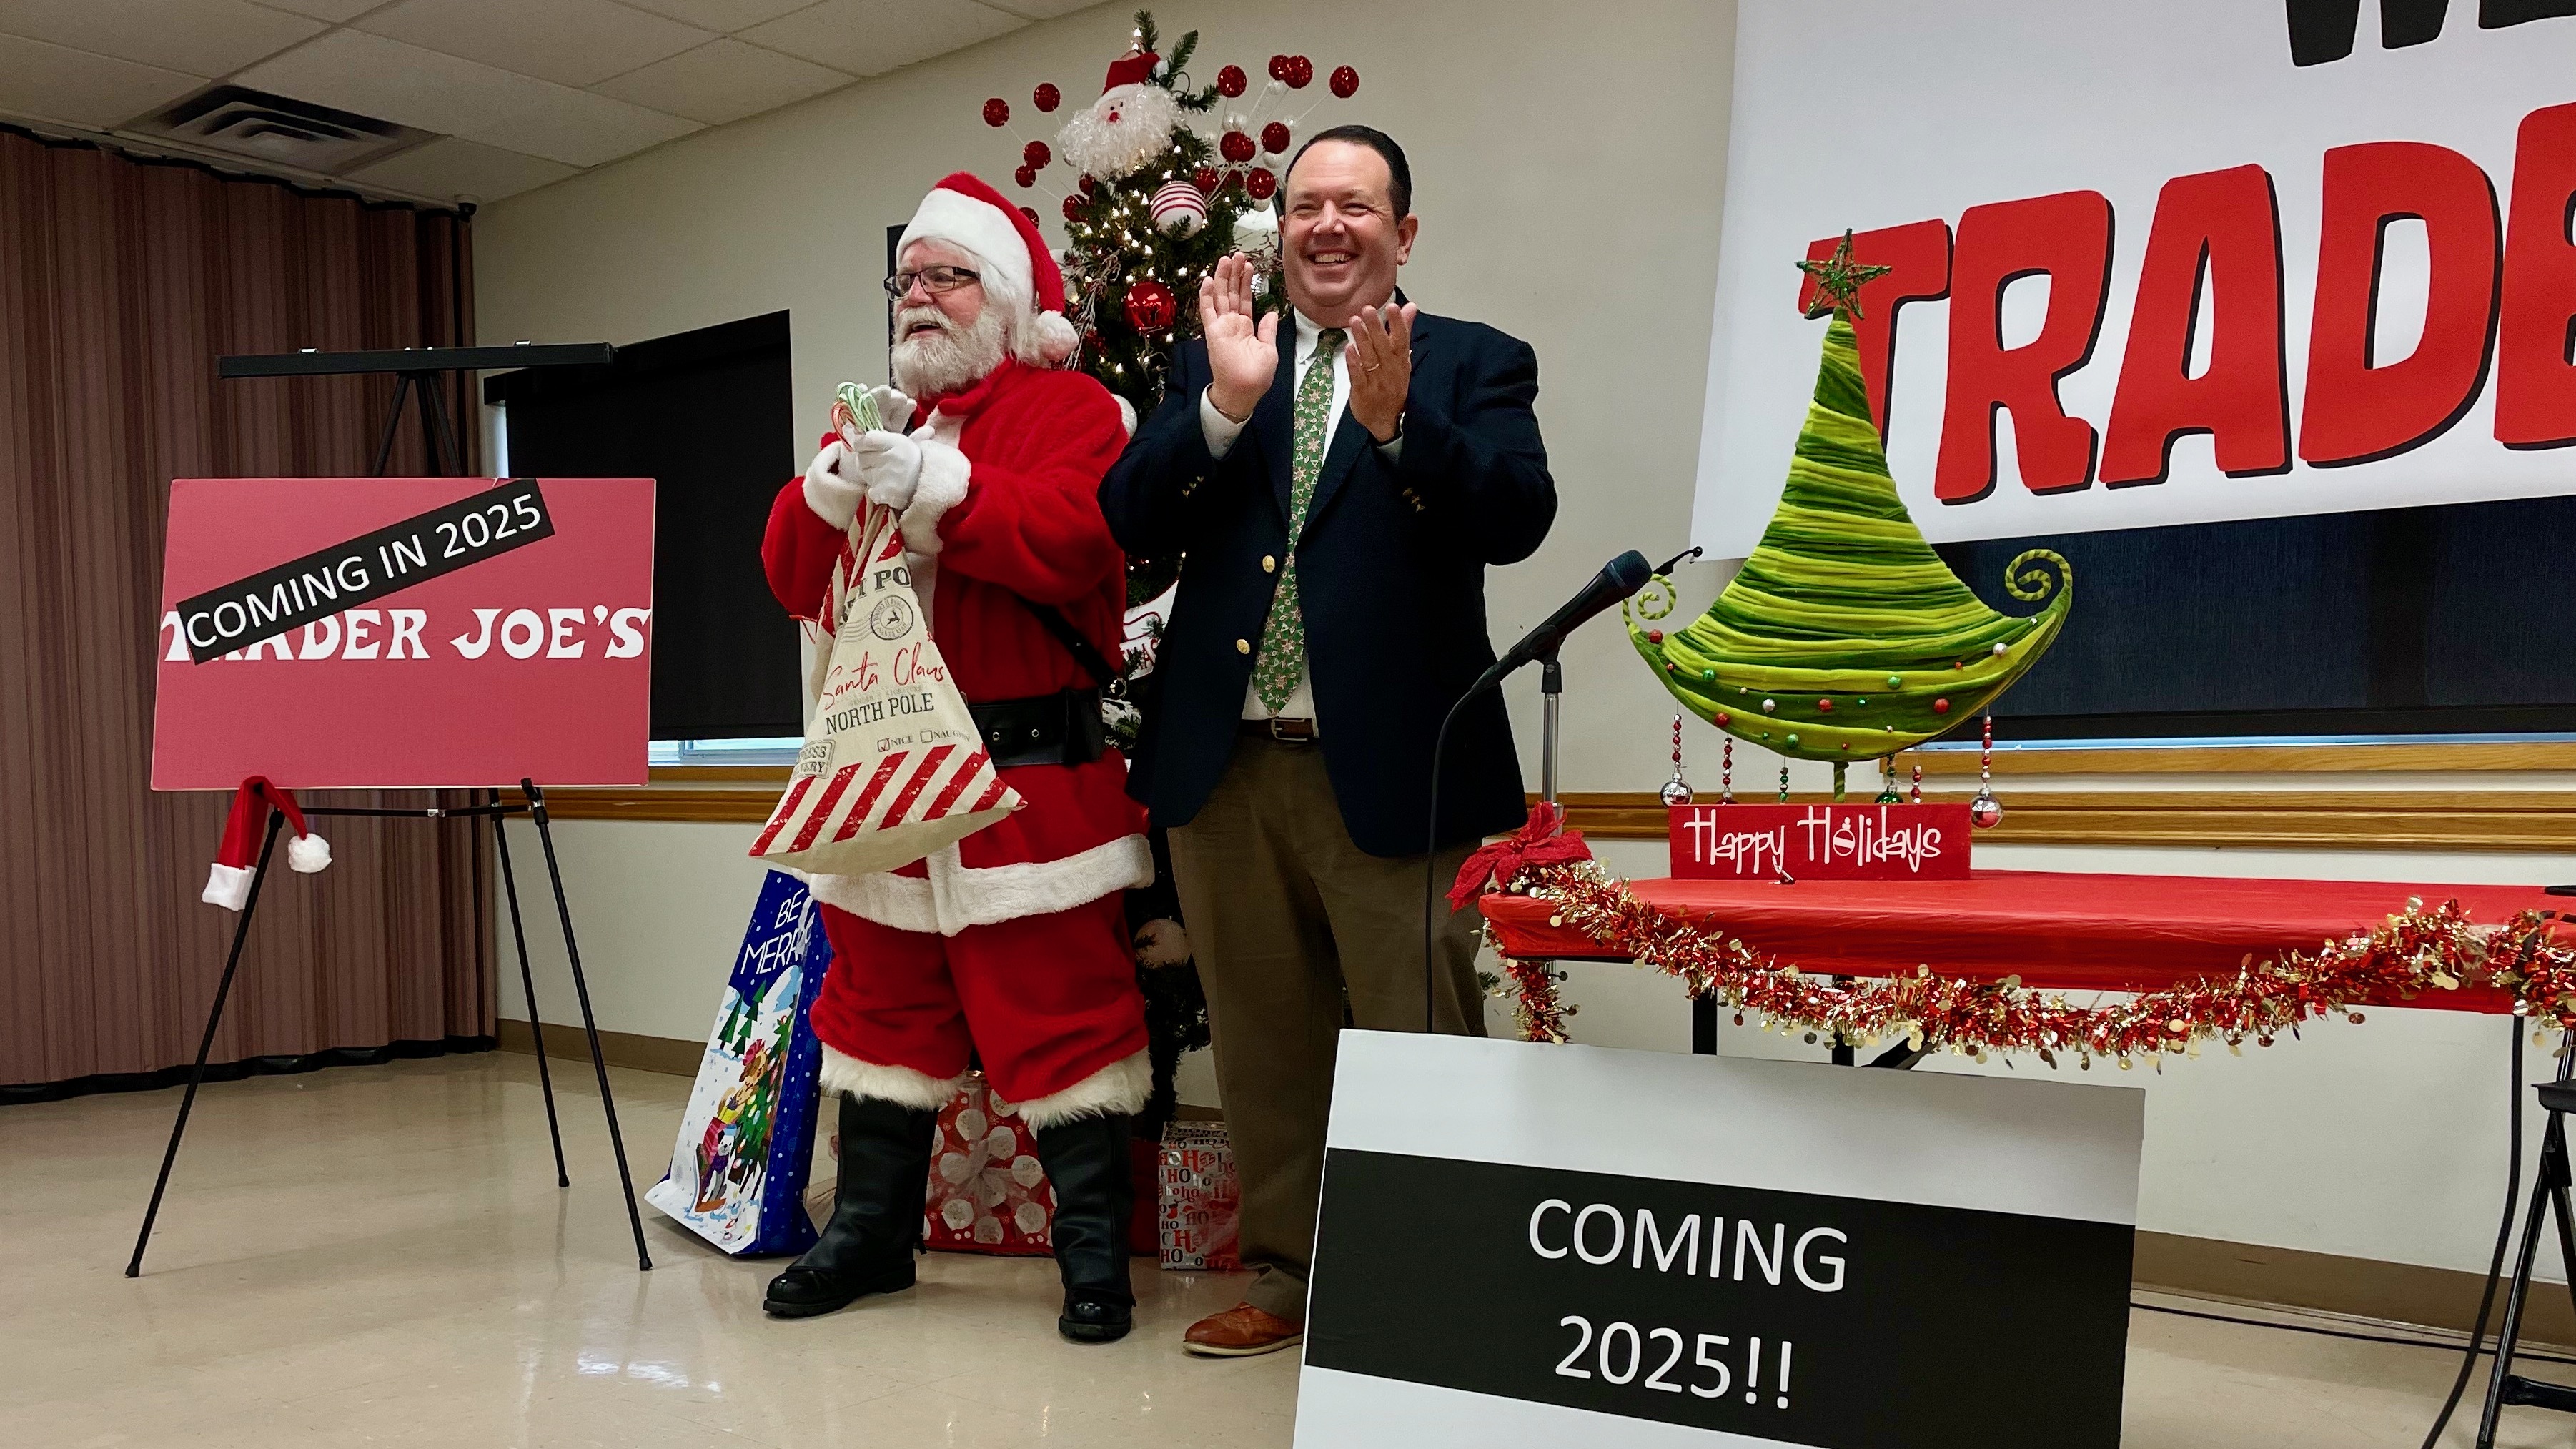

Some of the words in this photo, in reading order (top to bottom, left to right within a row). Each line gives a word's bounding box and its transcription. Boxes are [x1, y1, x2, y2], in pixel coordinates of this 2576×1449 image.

[187, 556, 370, 648] COMING
[378, 533, 427, 580] IN
[435, 493, 541, 560] 2025
[160, 609, 430, 661] TADER
[449, 604, 652, 660] JOE'S
[823, 651, 878, 711] Santa
[894, 641, 944, 686] Claus
[826, 701, 885, 735] NORTH
[888, 693, 935, 717] POLE
[891, 735, 914, 747] NICE
[1683, 808, 1785, 874] Happy
[1796, 805, 1941, 874] Holidays
[774, 888, 805, 929] BE
[740, 928, 801, 974] MERR
[1167, 1168, 1191, 1183] HO
[1161, 1249, 1184, 1263] HO
[1529, 1197, 1848, 1292] COMING
[1555, 1315, 1793, 1410] 2025!!
